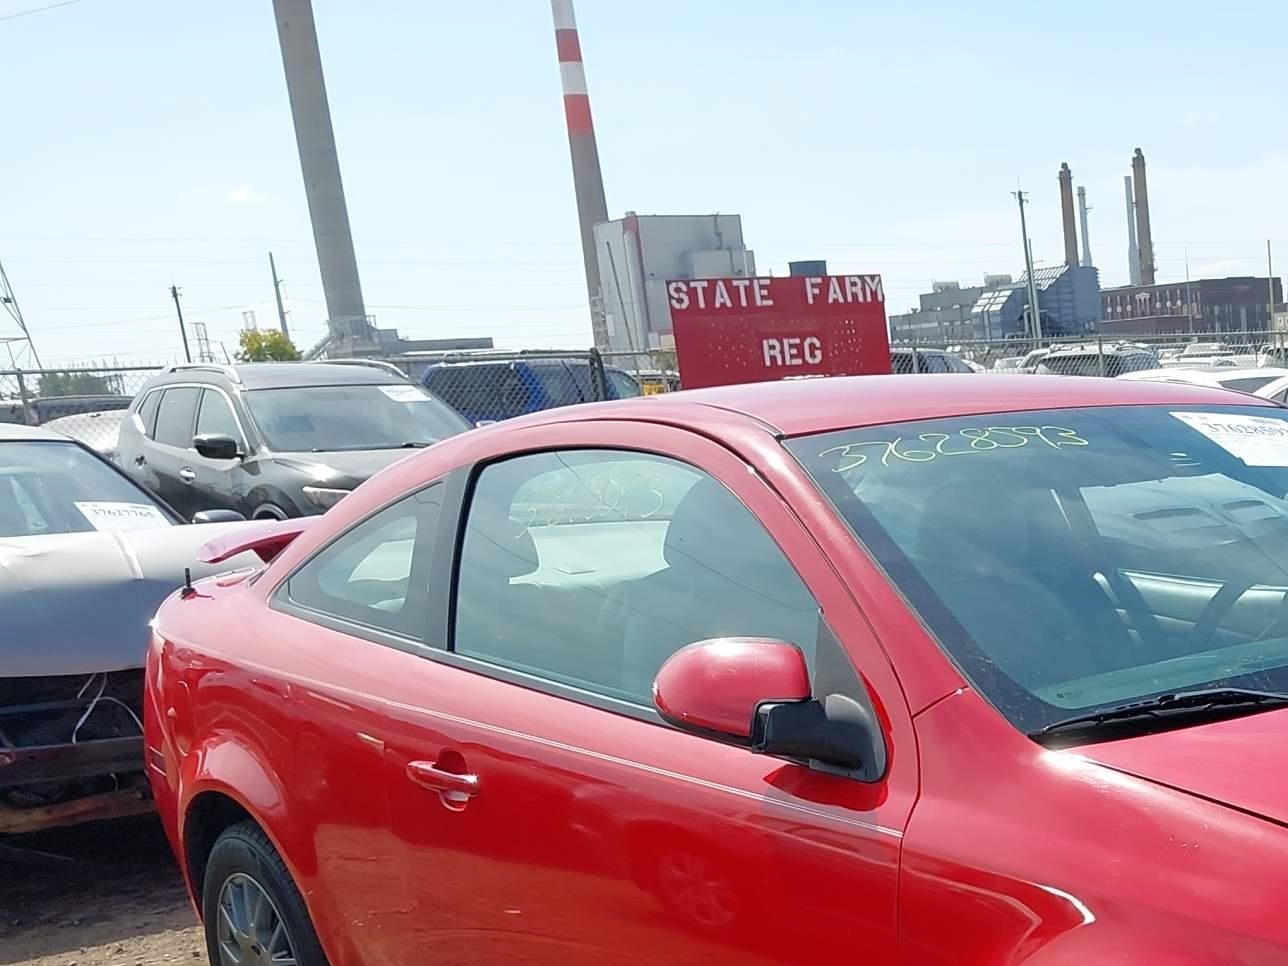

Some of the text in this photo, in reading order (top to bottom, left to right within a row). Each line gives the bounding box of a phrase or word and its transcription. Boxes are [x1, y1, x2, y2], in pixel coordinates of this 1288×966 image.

[668, 275, 885, 310] STATE FARM
[763, 336, 823, 367] REG
[818, 425, 1090, 473] 37628593
